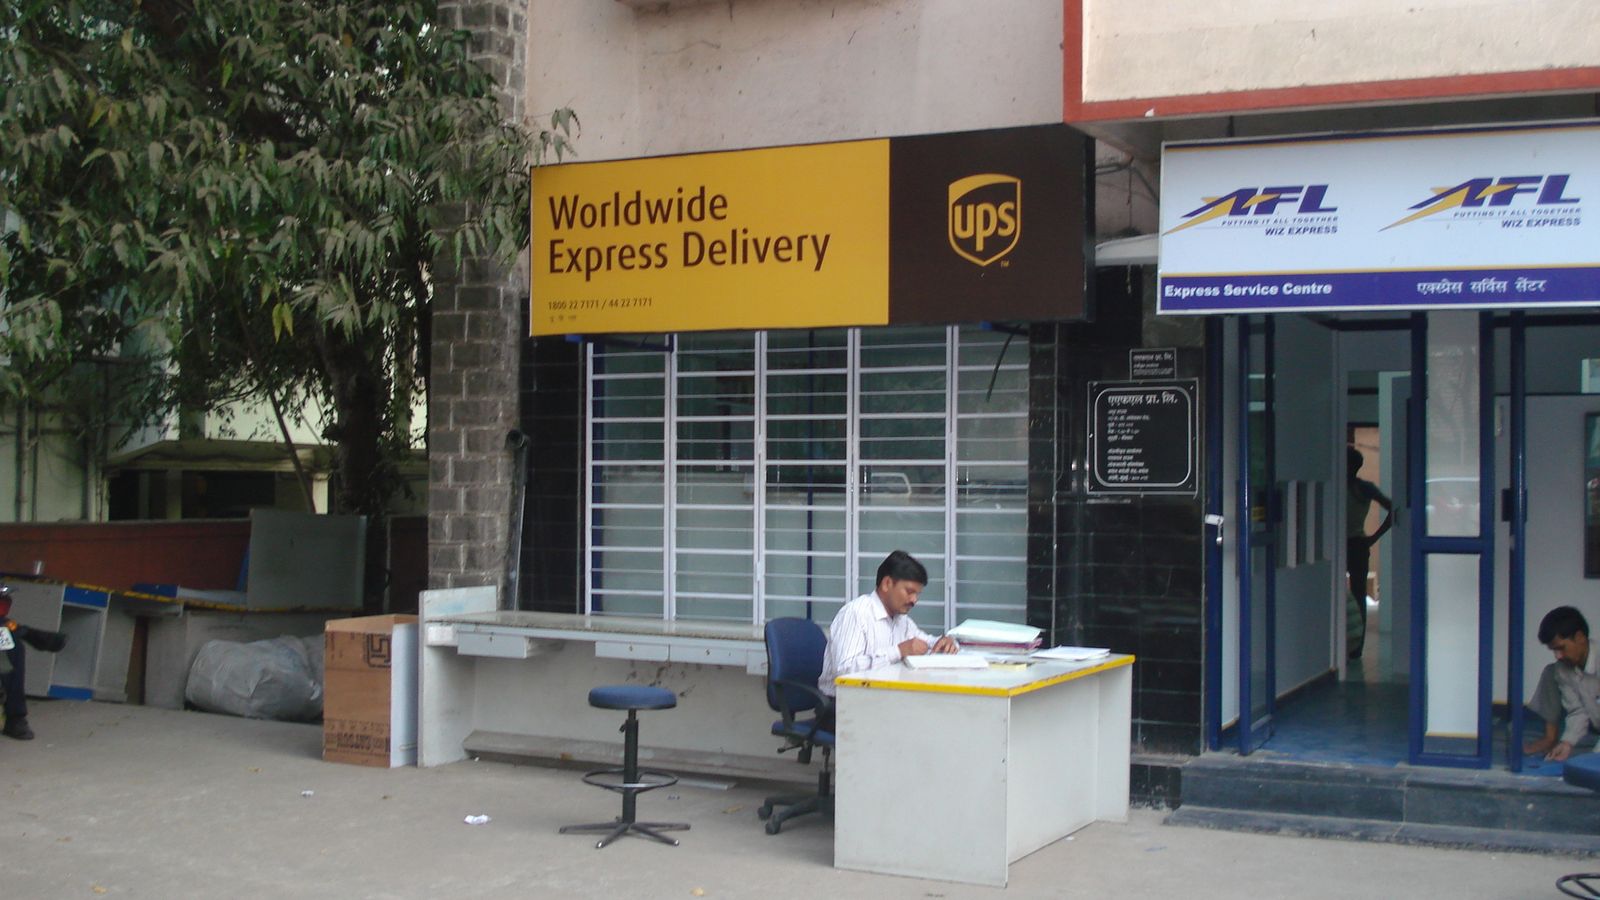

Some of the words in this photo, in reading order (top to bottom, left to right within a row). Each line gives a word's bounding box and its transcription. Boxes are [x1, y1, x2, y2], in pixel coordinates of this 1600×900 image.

[1408, 174, 1580, 209] AFL
[549, 185, 728, 231] Worldwide
[1181, 185, 1338, 217] AFL
[1292, 216, 1338, 224] TOGETHER
[1531, 208, 1581, 216] TOGETHER
[954, 200, 1015, 251] ups
[1288, 225, 1338, 236] EXPRESS
[1526, 218, 1581, 228] EXPRESS
[549, 237, 668, 281] Express
[683, 227, 831, 272] Delivery
[1164, 284, 1220, 299] Express
[1223, 283, 1279, 296] Service
[1282, 282, 1333, 295] Centre
[1470, 277, 1508, 294] सर्विस
[548, 301, 566, 310] 1800
[570, 300, 577, 309] 22
[581, 300, 598, 309] 7171
[609, 299, 618, 308] 44
[622, 298, 630, 308] 22
[634, 297, 652, 306] 7171
